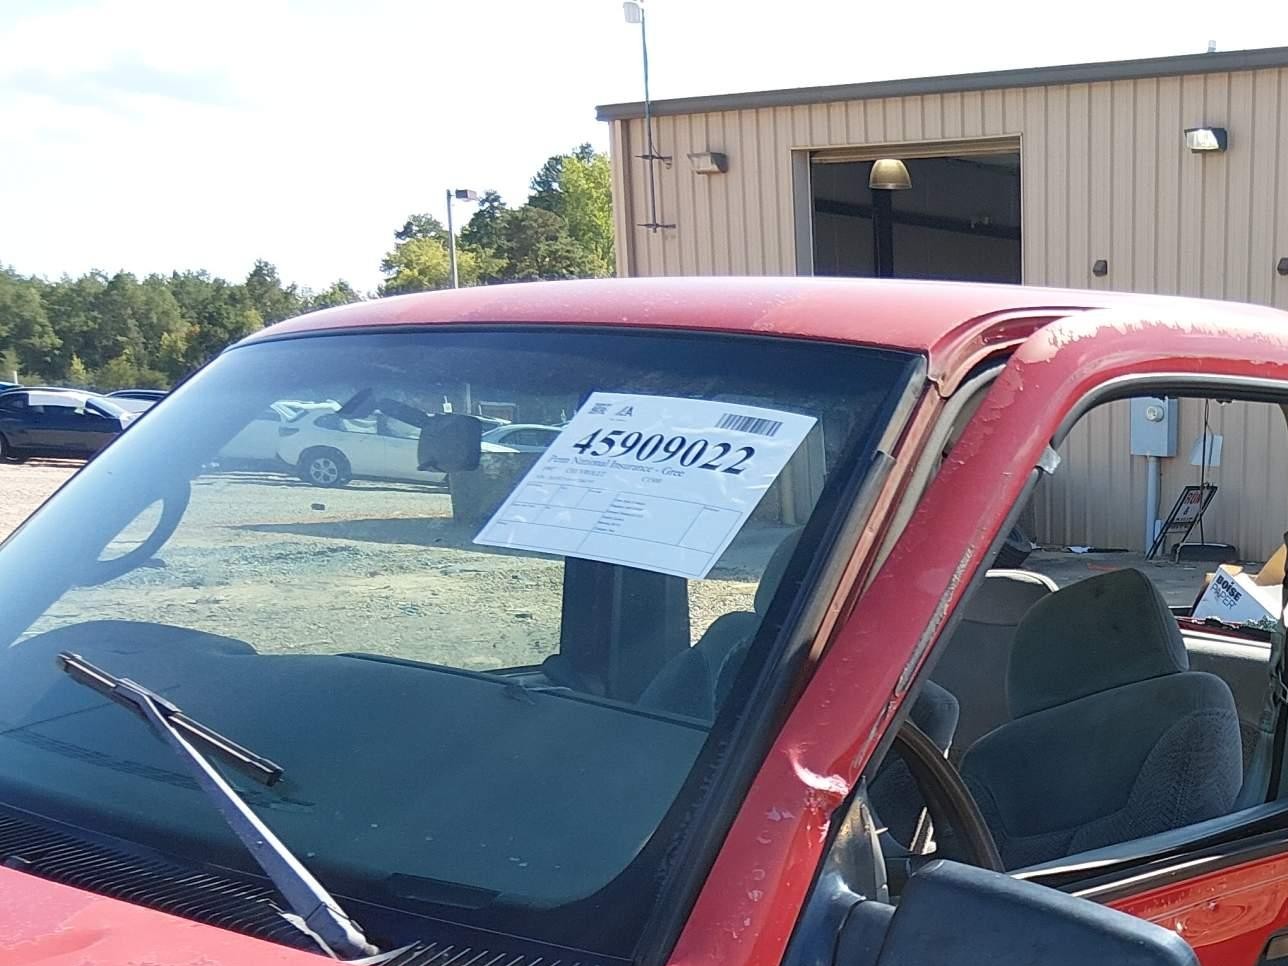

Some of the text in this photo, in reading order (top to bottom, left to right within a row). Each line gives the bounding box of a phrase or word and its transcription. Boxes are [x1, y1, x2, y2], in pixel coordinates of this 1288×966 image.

[572, 428, 756, 475] 45909022
[609, 460, 655, 473] Insurance
[1211, 583, 1237, 609] PAPER
